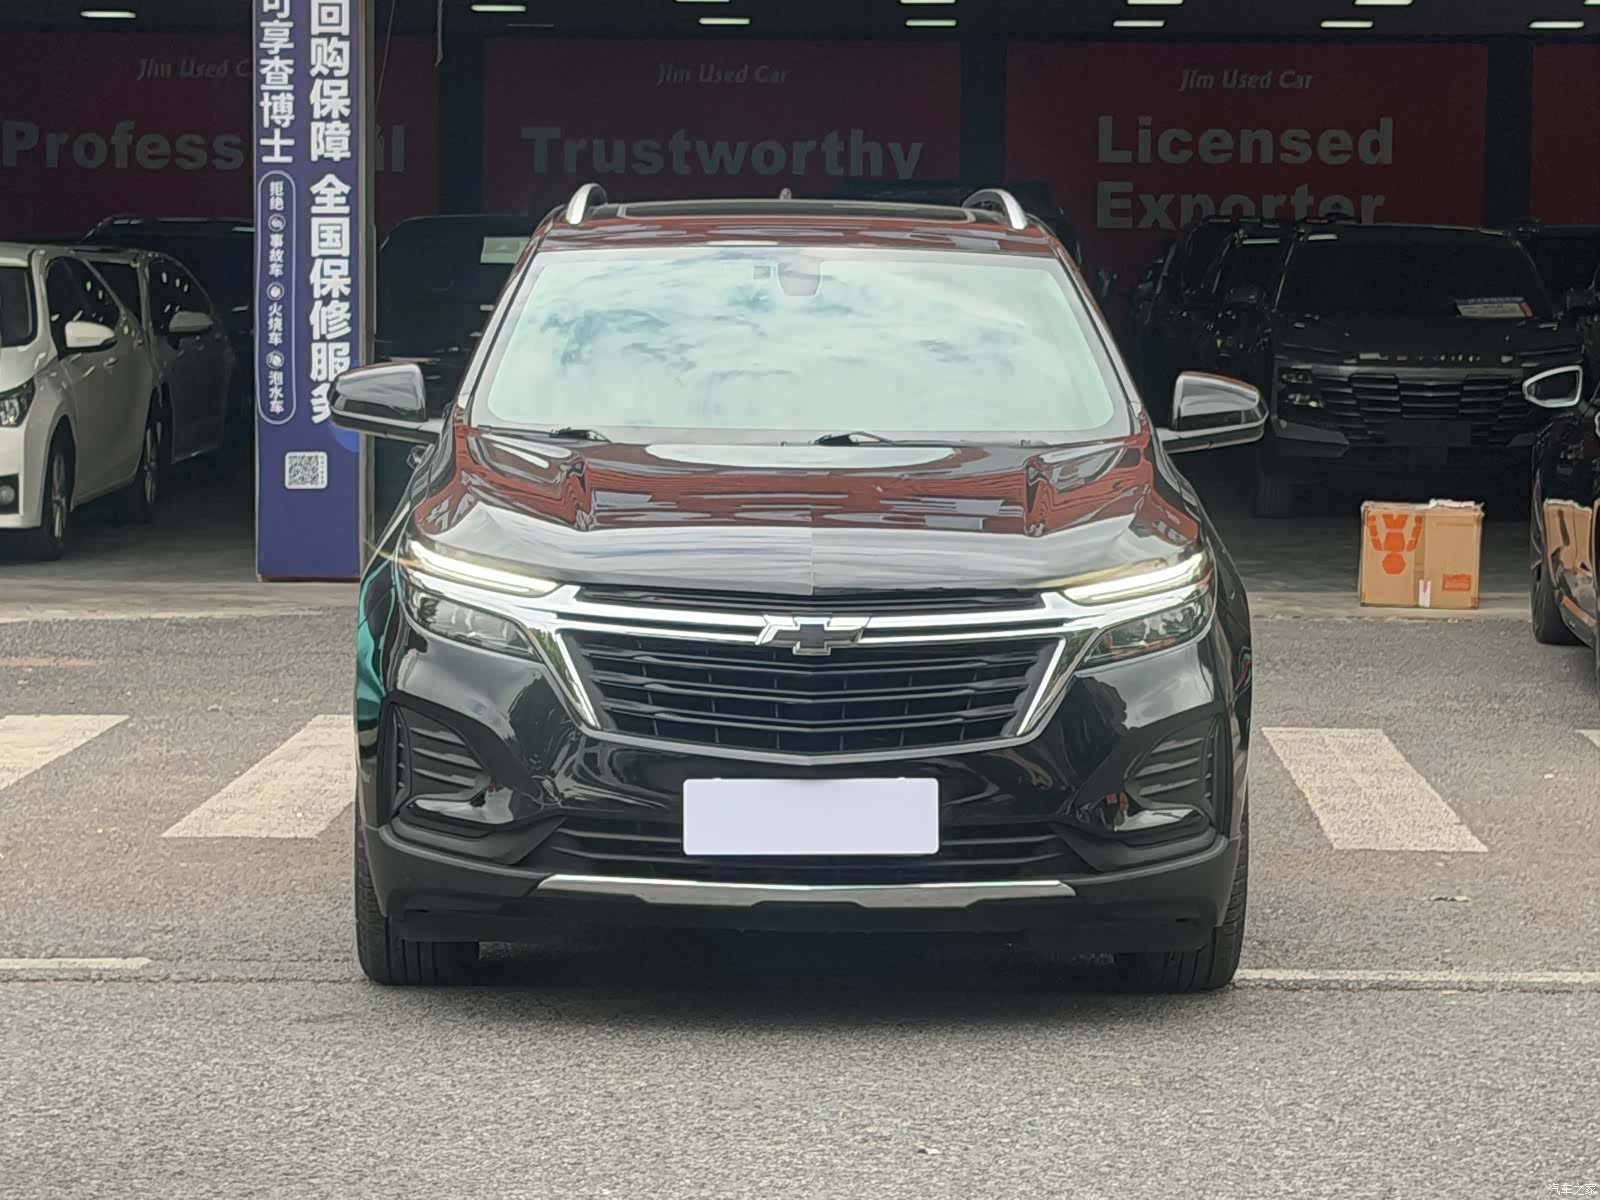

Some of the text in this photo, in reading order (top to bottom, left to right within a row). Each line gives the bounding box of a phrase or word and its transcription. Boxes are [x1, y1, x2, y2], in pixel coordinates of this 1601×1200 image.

[309, 0, 352, 161] 回购保障
[1178, 69, 1314, 92] Jim Used Car
[520, 126, 924, 180] Trustworthy
[1097, 114, 1395, 166] Licensed
[268, 234, 285, 277] 事故车
[267, 302, 284, 346] 火烧车
[268, 370, 286, 414] 泡水车
